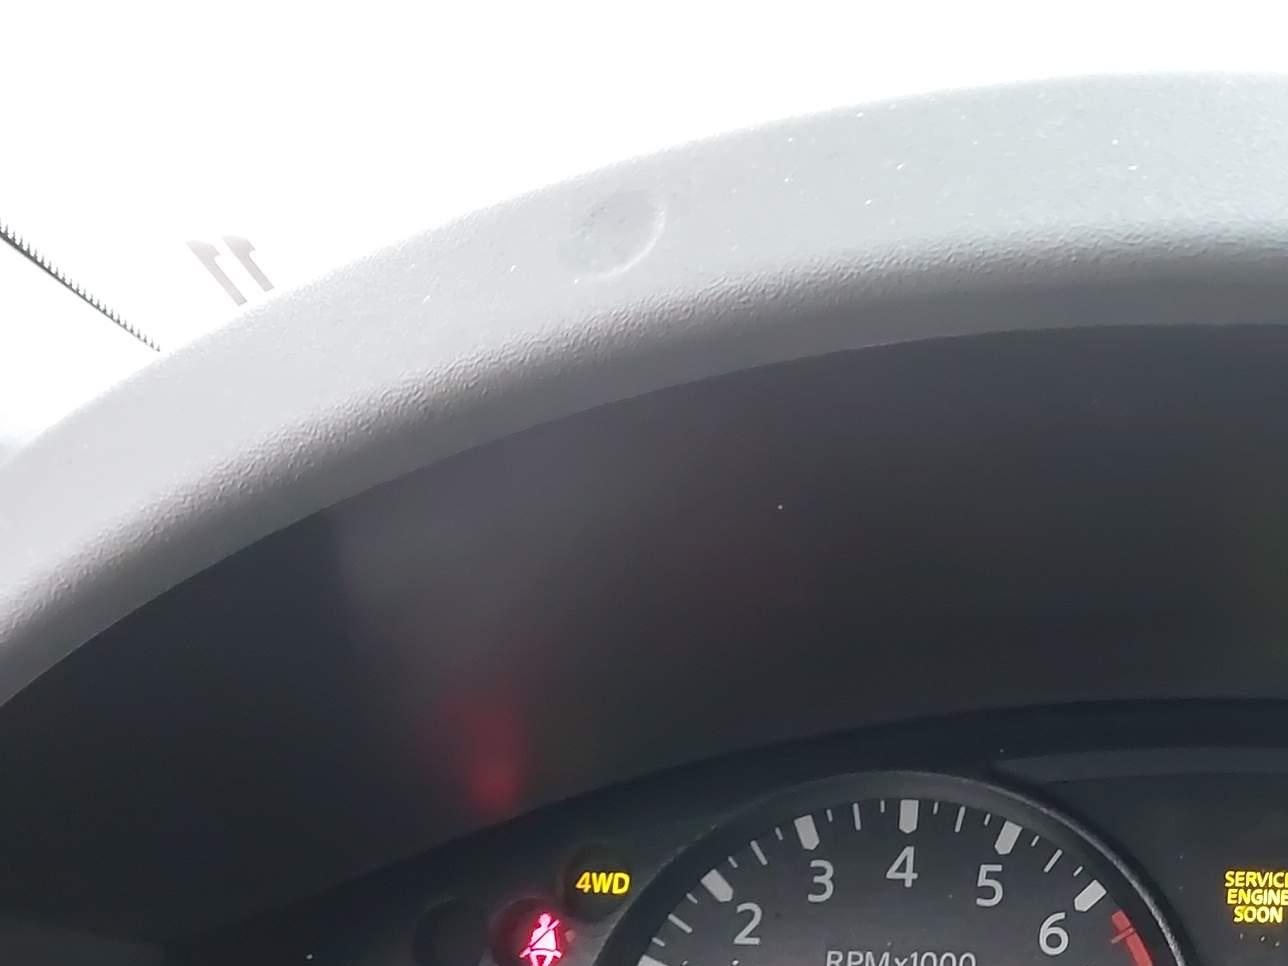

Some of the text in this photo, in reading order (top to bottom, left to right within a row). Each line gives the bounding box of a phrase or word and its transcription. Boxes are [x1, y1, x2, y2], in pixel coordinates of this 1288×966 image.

[575, 872, 630, 894] 4WD
[807, 859, 834, 903] 3
[886, 846, 918, 888] 4
[975, 864, 1004, 907] 5
[733, 902, 763, 945] 2
[1038, 911, 1070, 956] 6
[1233, 905, 1284, 923] SOON
